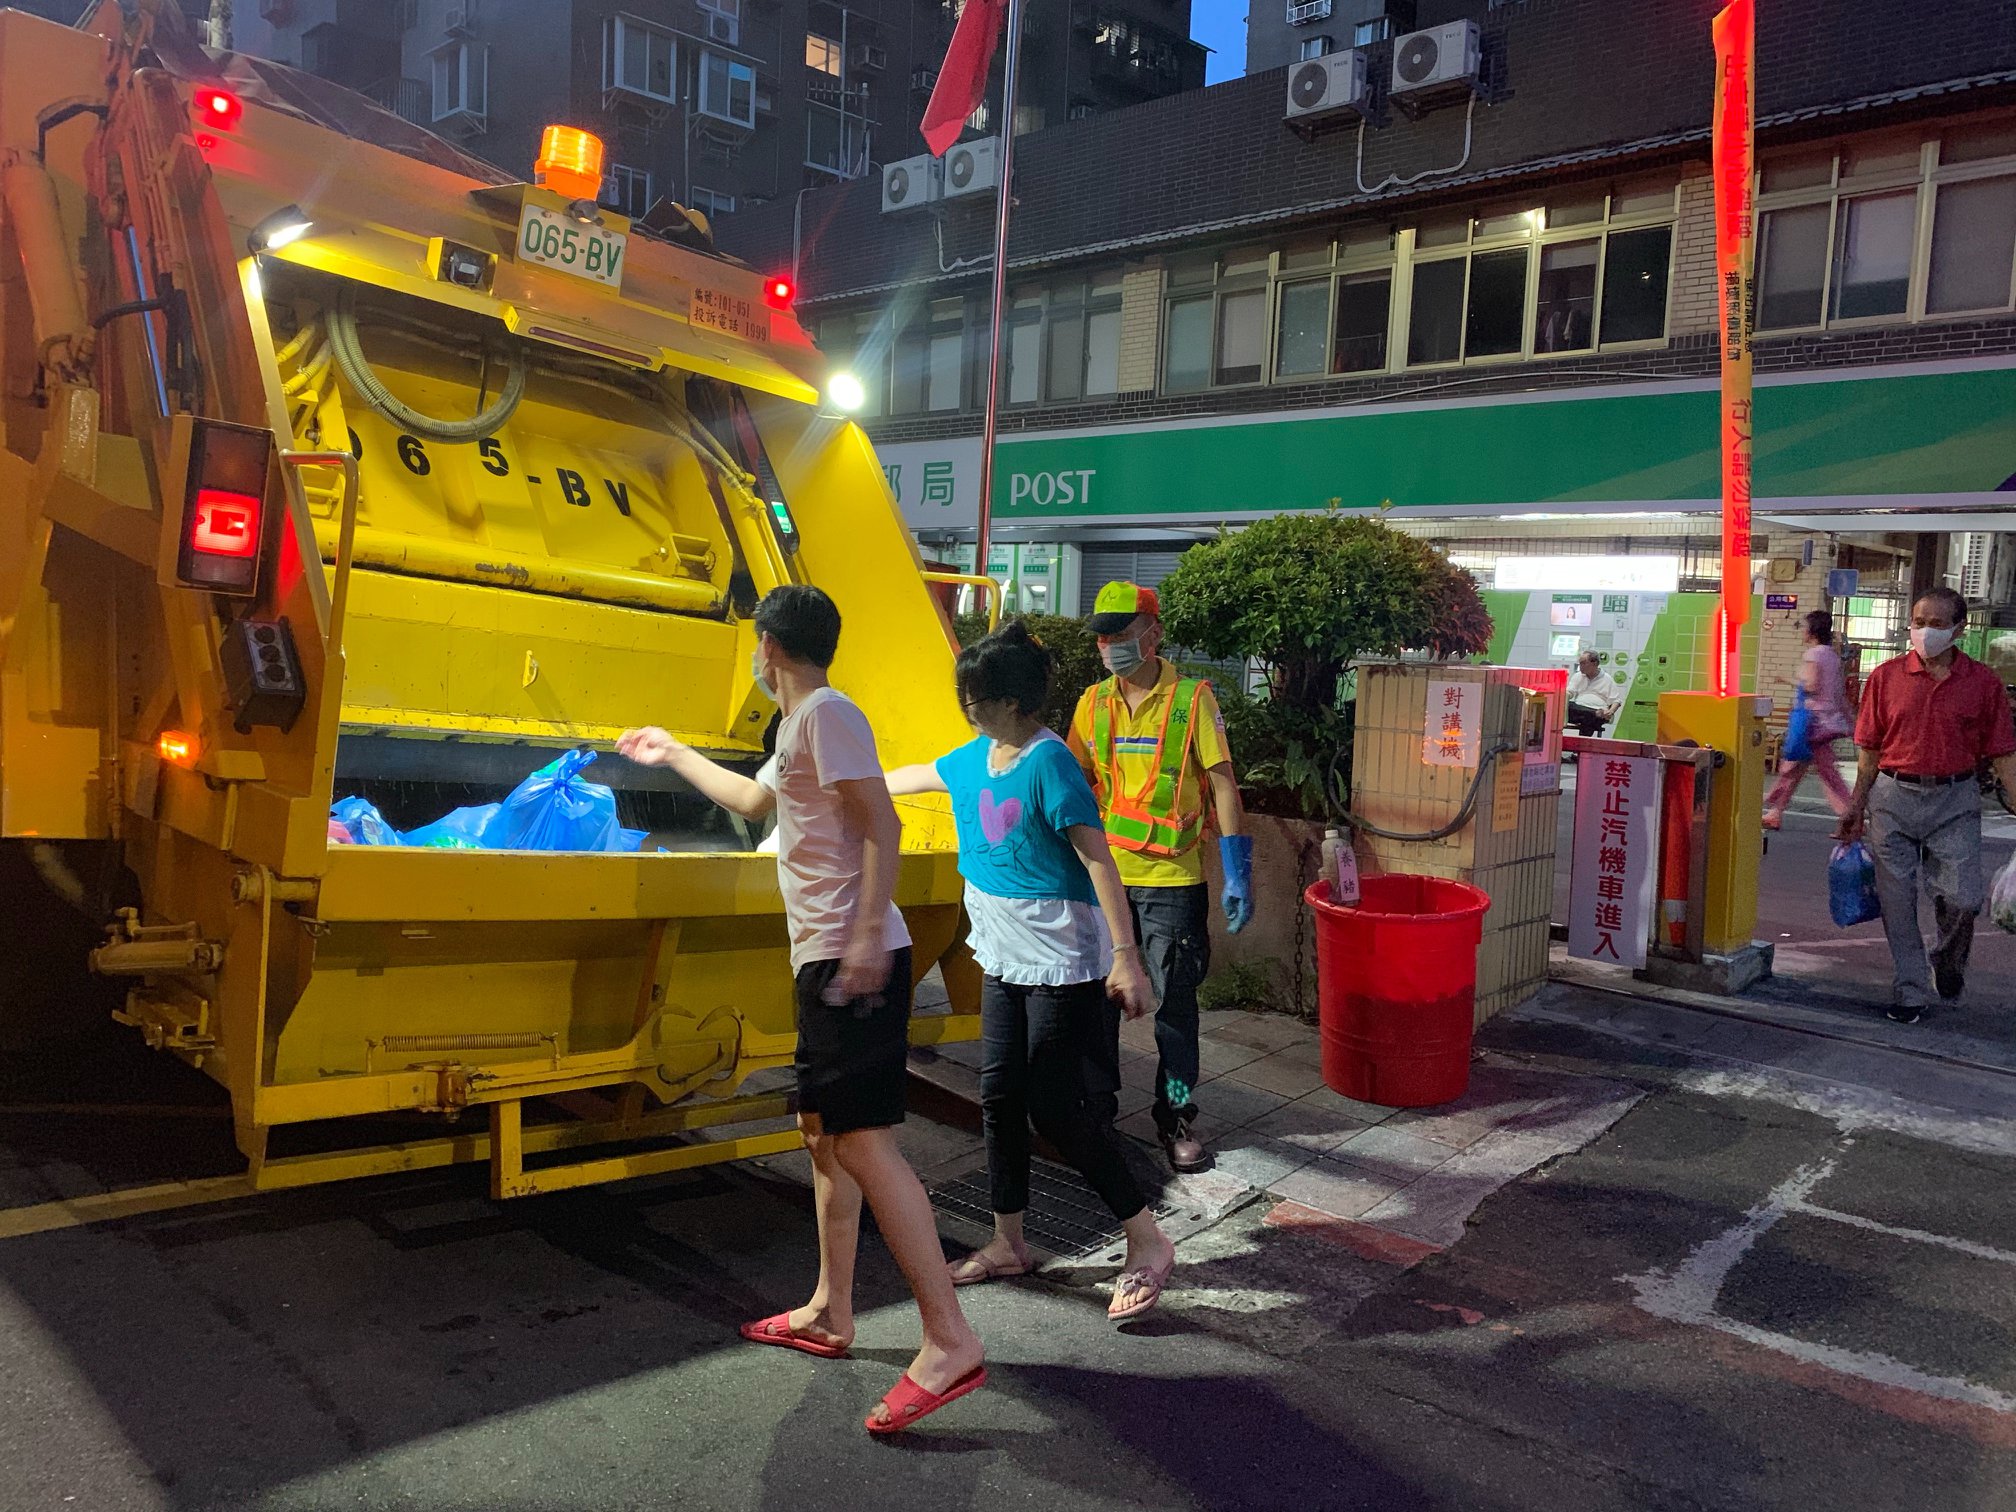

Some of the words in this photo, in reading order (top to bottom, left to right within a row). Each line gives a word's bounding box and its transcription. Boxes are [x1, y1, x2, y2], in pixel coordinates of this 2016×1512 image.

[524, 218, 622, 277] 065-BV
[693, 306, 739, 332] 投訴電話
[745, 321, 767, 342] 1999
[1010, 469, 1097, 506] POST
[1731, 398, 1752, 557] 行人請勿穿越
[1172, 707, 1188, 725] 保
[1439, 686, 1465, 760] 對講機
[1593, 760, 1632, 960] 禁止汽機車進入
